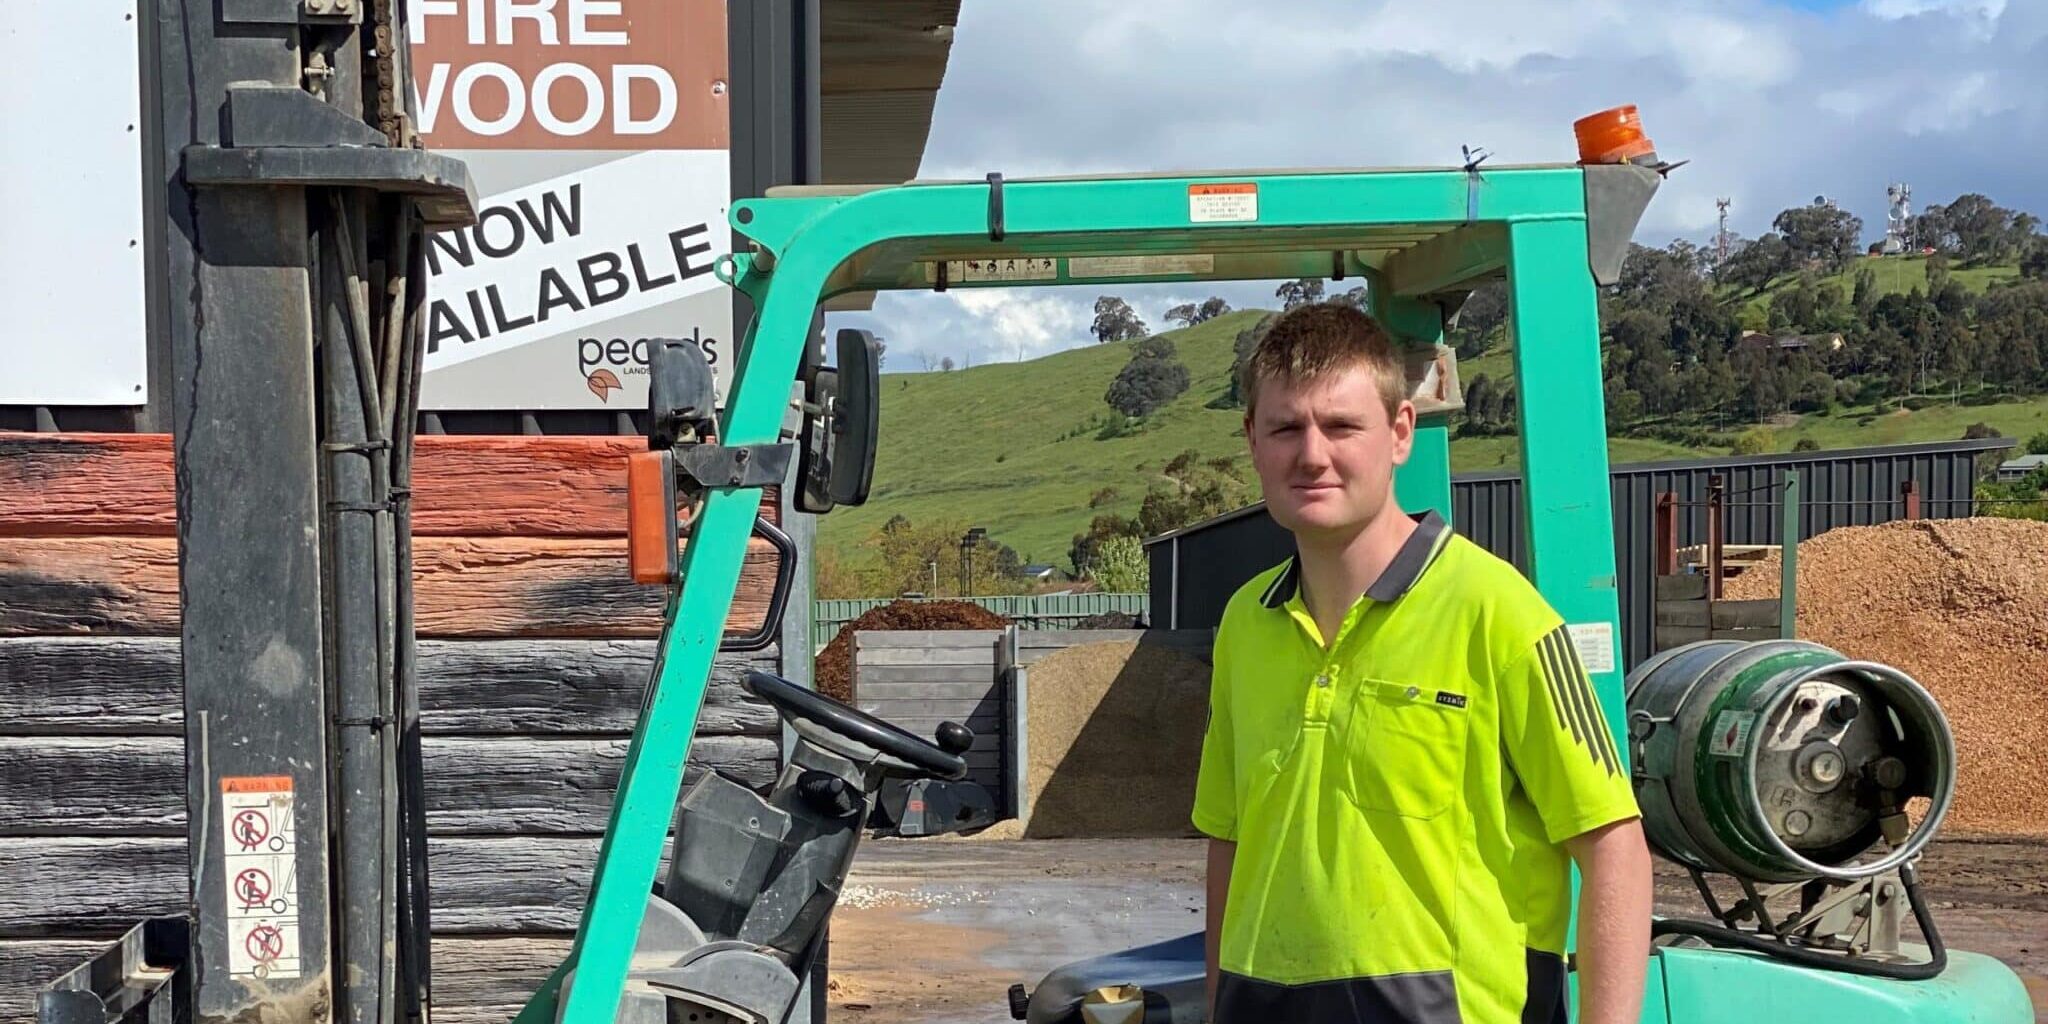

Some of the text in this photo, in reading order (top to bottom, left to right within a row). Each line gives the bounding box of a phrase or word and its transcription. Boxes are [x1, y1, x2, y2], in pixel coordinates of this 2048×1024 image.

[406, 0, 627, 45] FIRE
[425, 184, 581, 276] NOW
[427, 222, 714, 354] AILABLE
